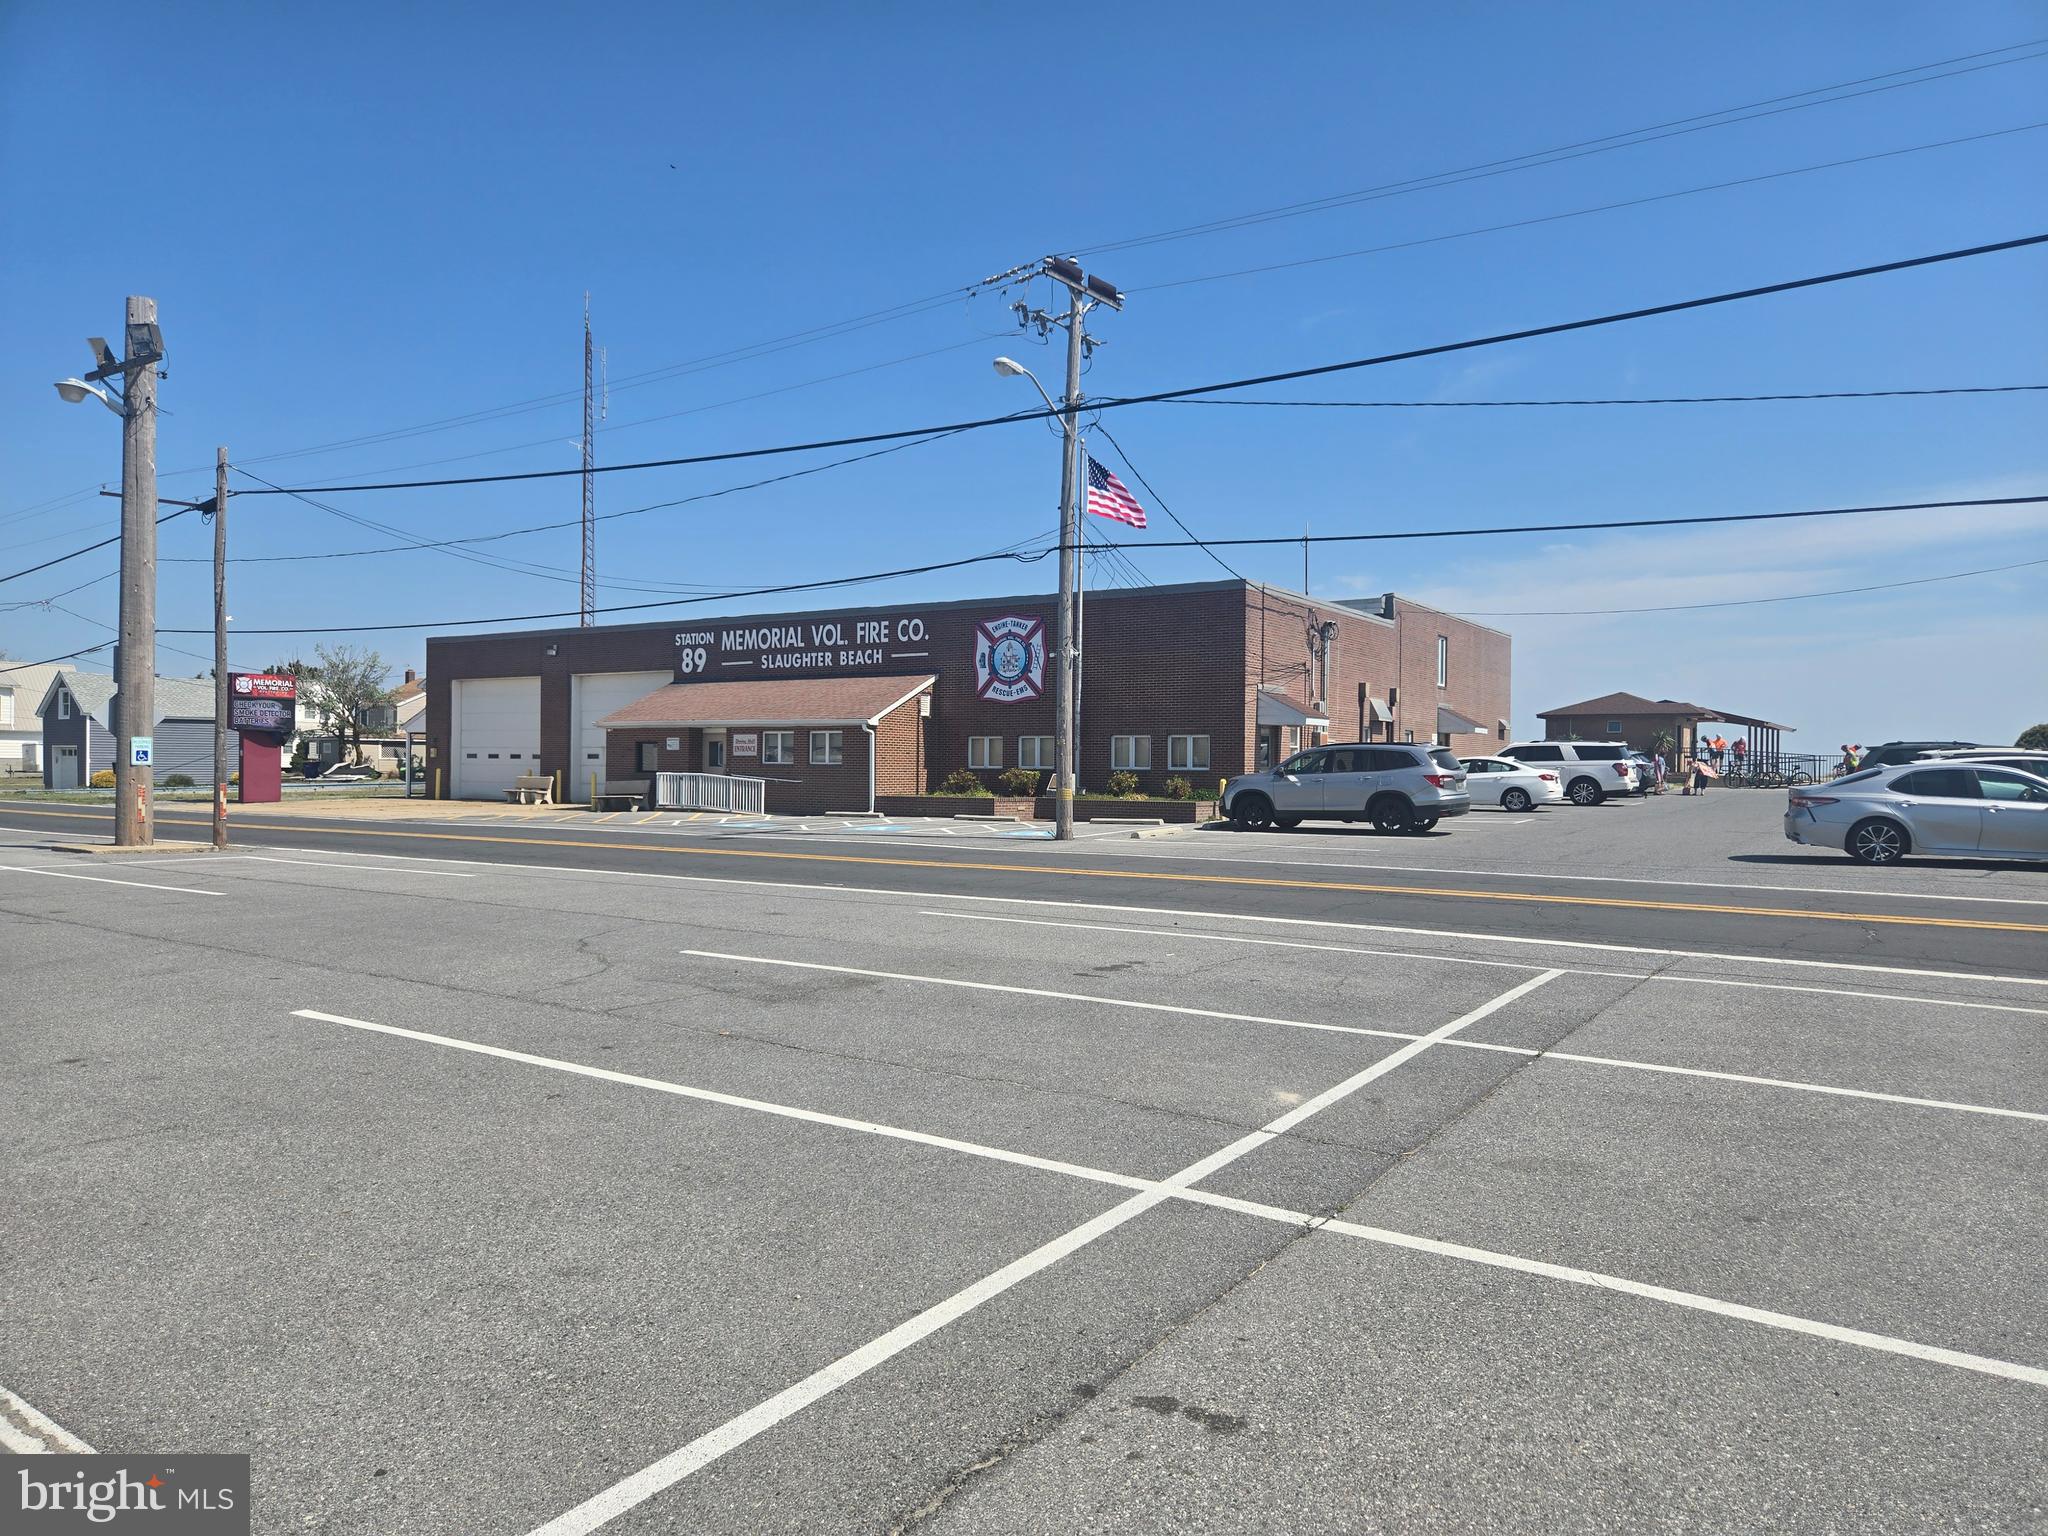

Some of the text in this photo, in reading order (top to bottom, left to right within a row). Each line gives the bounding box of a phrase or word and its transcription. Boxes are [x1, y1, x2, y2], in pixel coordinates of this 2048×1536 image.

[675, 632, 714, 646] STATION
[721, 618, 929, 652] MEMORIAL VOL. FIRE CO.
[681, 647, 707, 674] 89
[761, 649, 883, 669] SLAUGHTER BEACH
[253, 679, 293, 687] MEMORIAL
[991, 685, 1028, 697] RESCUE-EMS
[233, 700, 277, 709] CHECK YOUR
[233, 708, 292, 719] SMOKE DETECTOR
